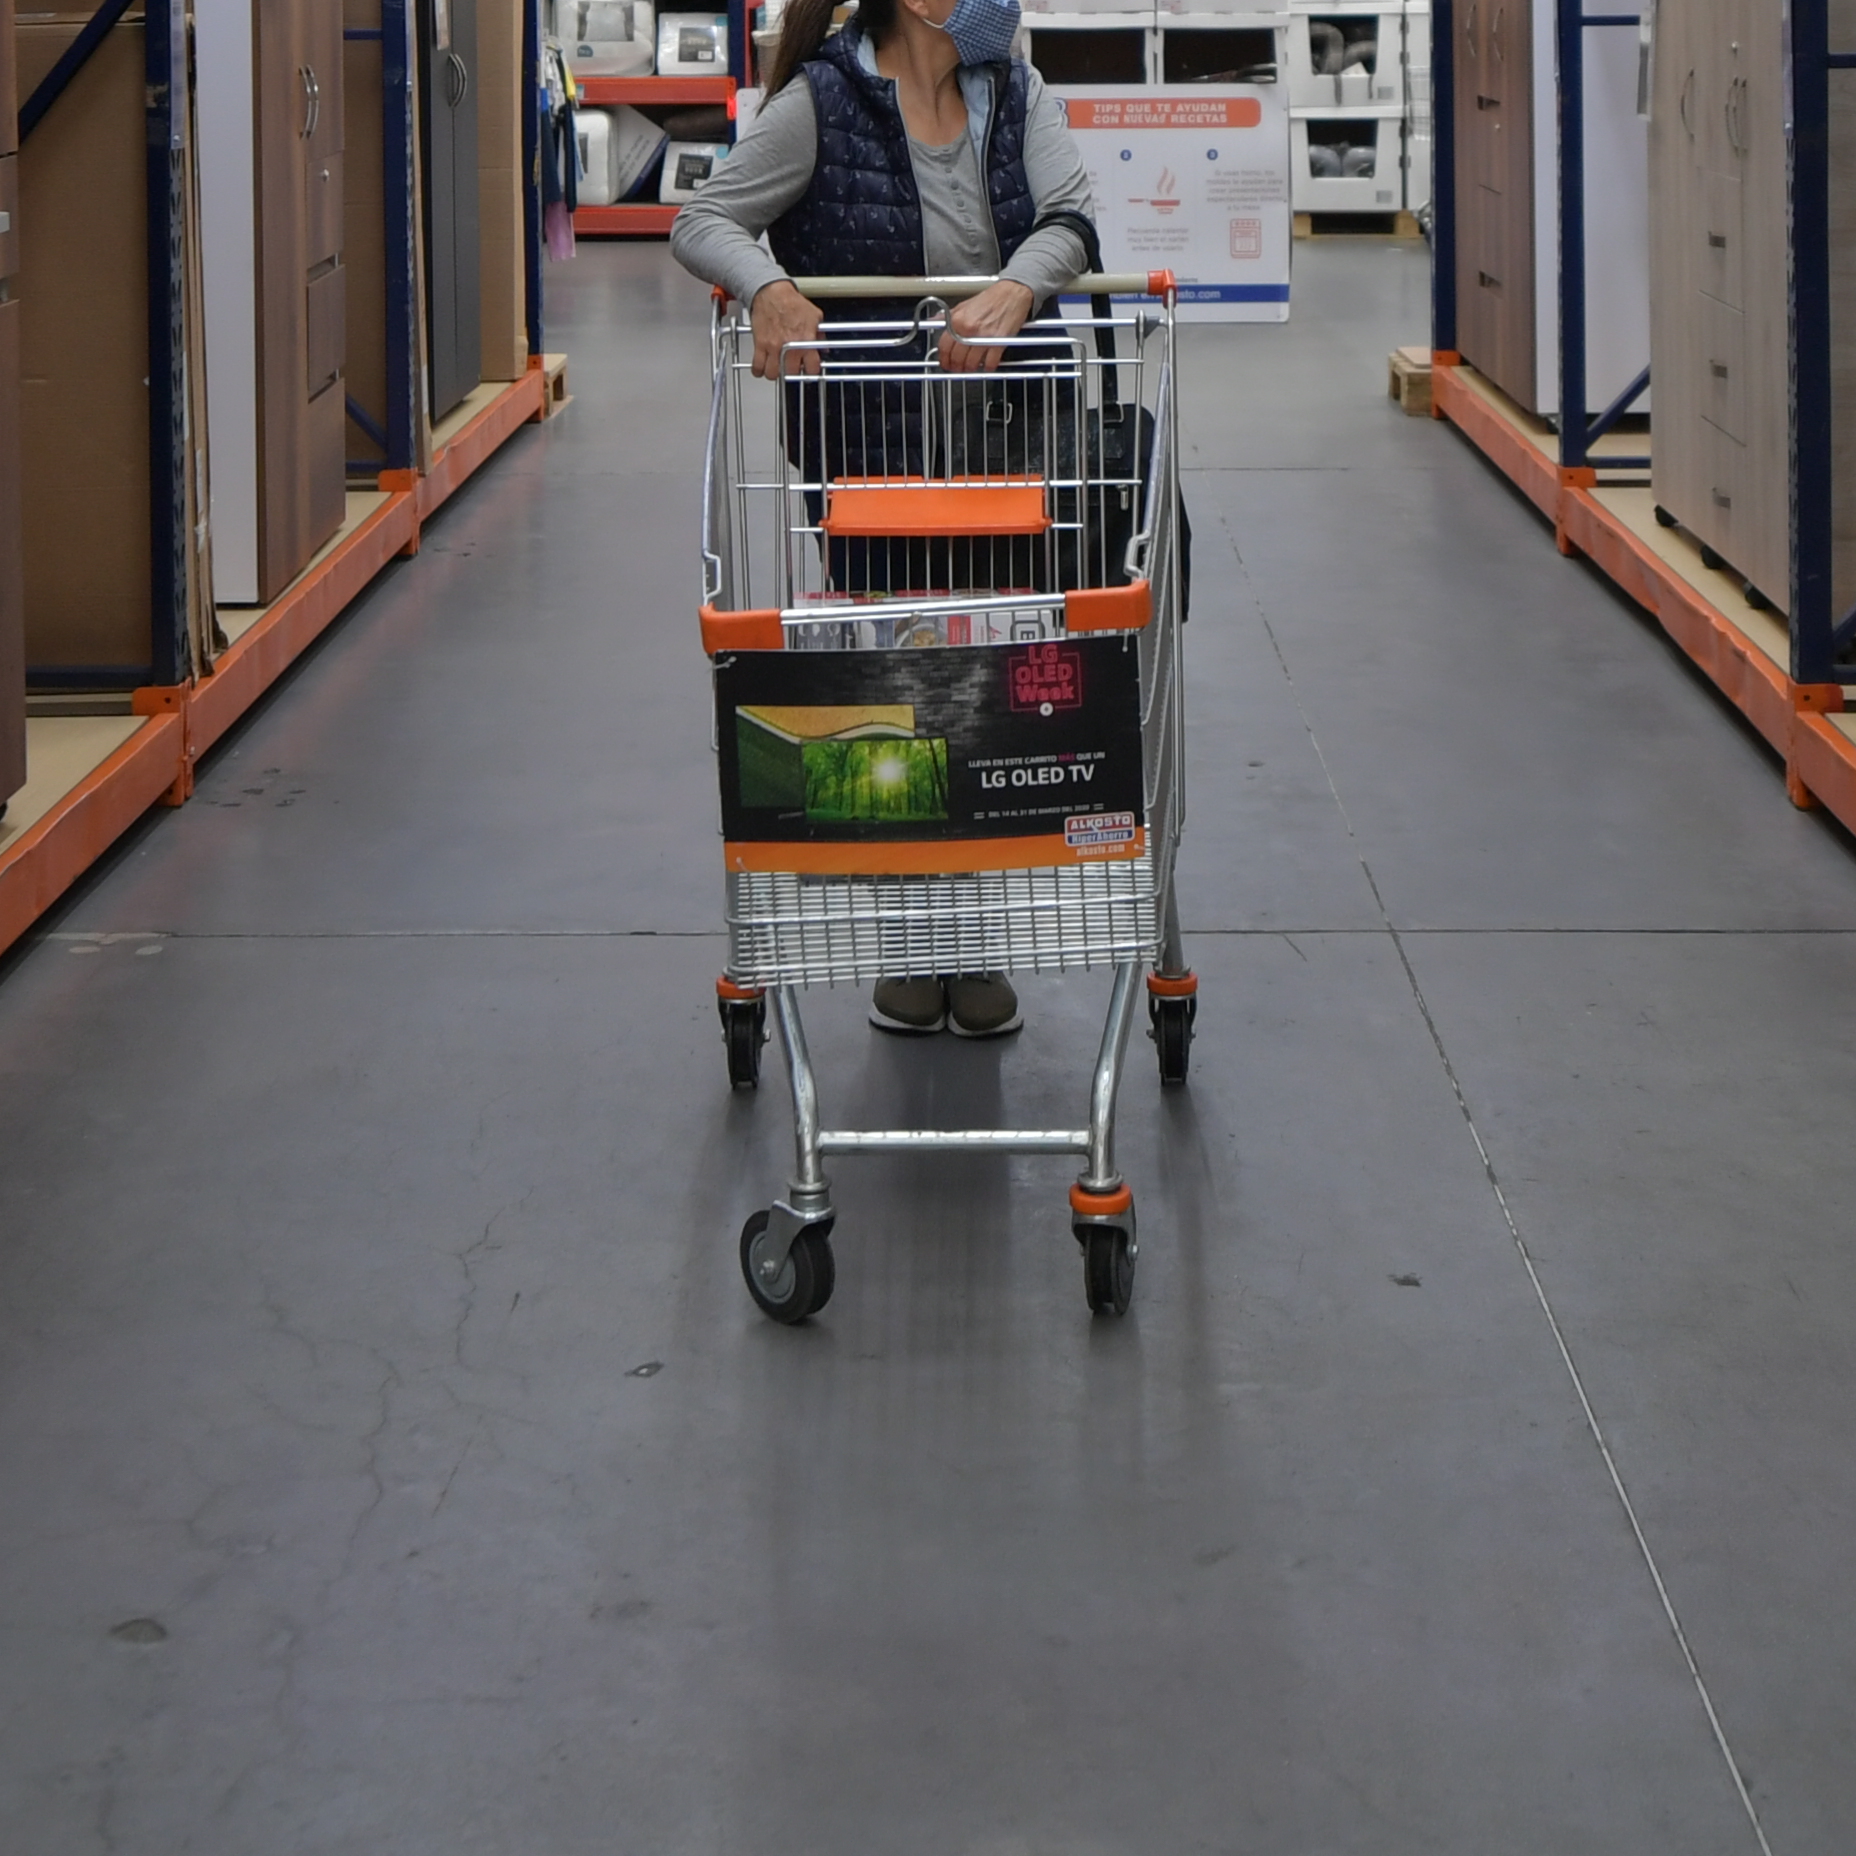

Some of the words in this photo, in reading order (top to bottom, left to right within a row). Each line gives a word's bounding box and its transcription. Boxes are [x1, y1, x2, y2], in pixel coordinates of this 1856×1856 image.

[1093, 103, 1122, 114] TIPS
[1126, 102, 1151, 113] QUE
[1156, 102, 1172, 113] TE
[1176, 102, 1227, 113] AYUDAN
[1093, 114, 1119, 124] CON
[1123, 113, 1167, 124] NUEVAS
[1171, 113, 1228, 124] RECETAS
[1027, 644, 1059, 665] LG
[1015, 663, 1074, 685] OLED
[1016, 682, 1075, 703] Week
[968, 759, 992, 768] LLEVA
[993, 758, 1004, 767] EN
[1005, 757, 1023, 766] ESTE
[1025, 755, 1057, 765] CARRITO
[1076, 752, 1092, 761] QUE
[1094, 751, 1105, 760] UN
[981, 770, 1006, 789] LG
[1011, 766, 1065, 787] OLED
[1068, 763, 1095, 783] TV
[1070, 814, 1131, 831] ALKOSTO
[1072, 830, 1129, 844] HiperAhorro
[1077, 843, 1125, 857] alkosto.com
